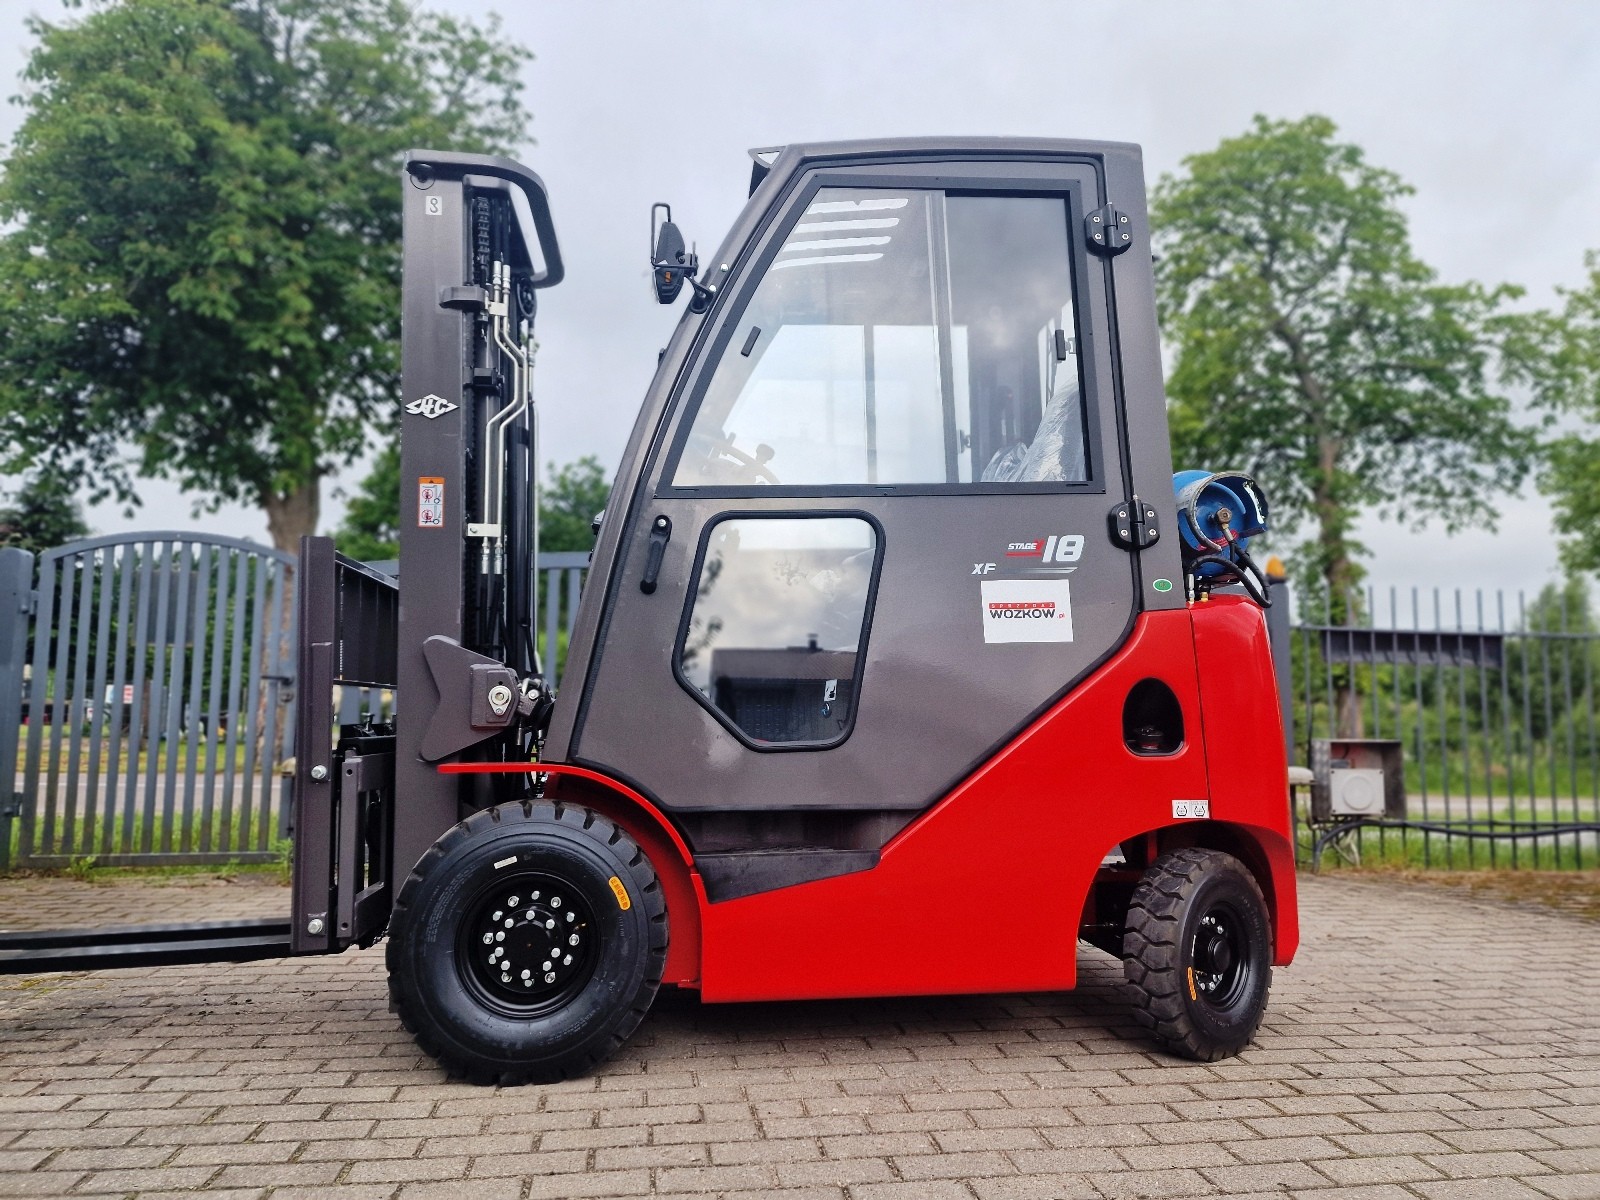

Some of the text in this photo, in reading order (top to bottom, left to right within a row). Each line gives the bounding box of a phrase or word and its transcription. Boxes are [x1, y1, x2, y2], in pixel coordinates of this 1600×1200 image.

[1007, 542, 1038, 550] STAGE
[1042, 535, 1085, 562] 18
[971, 563, 997, 575] XF
